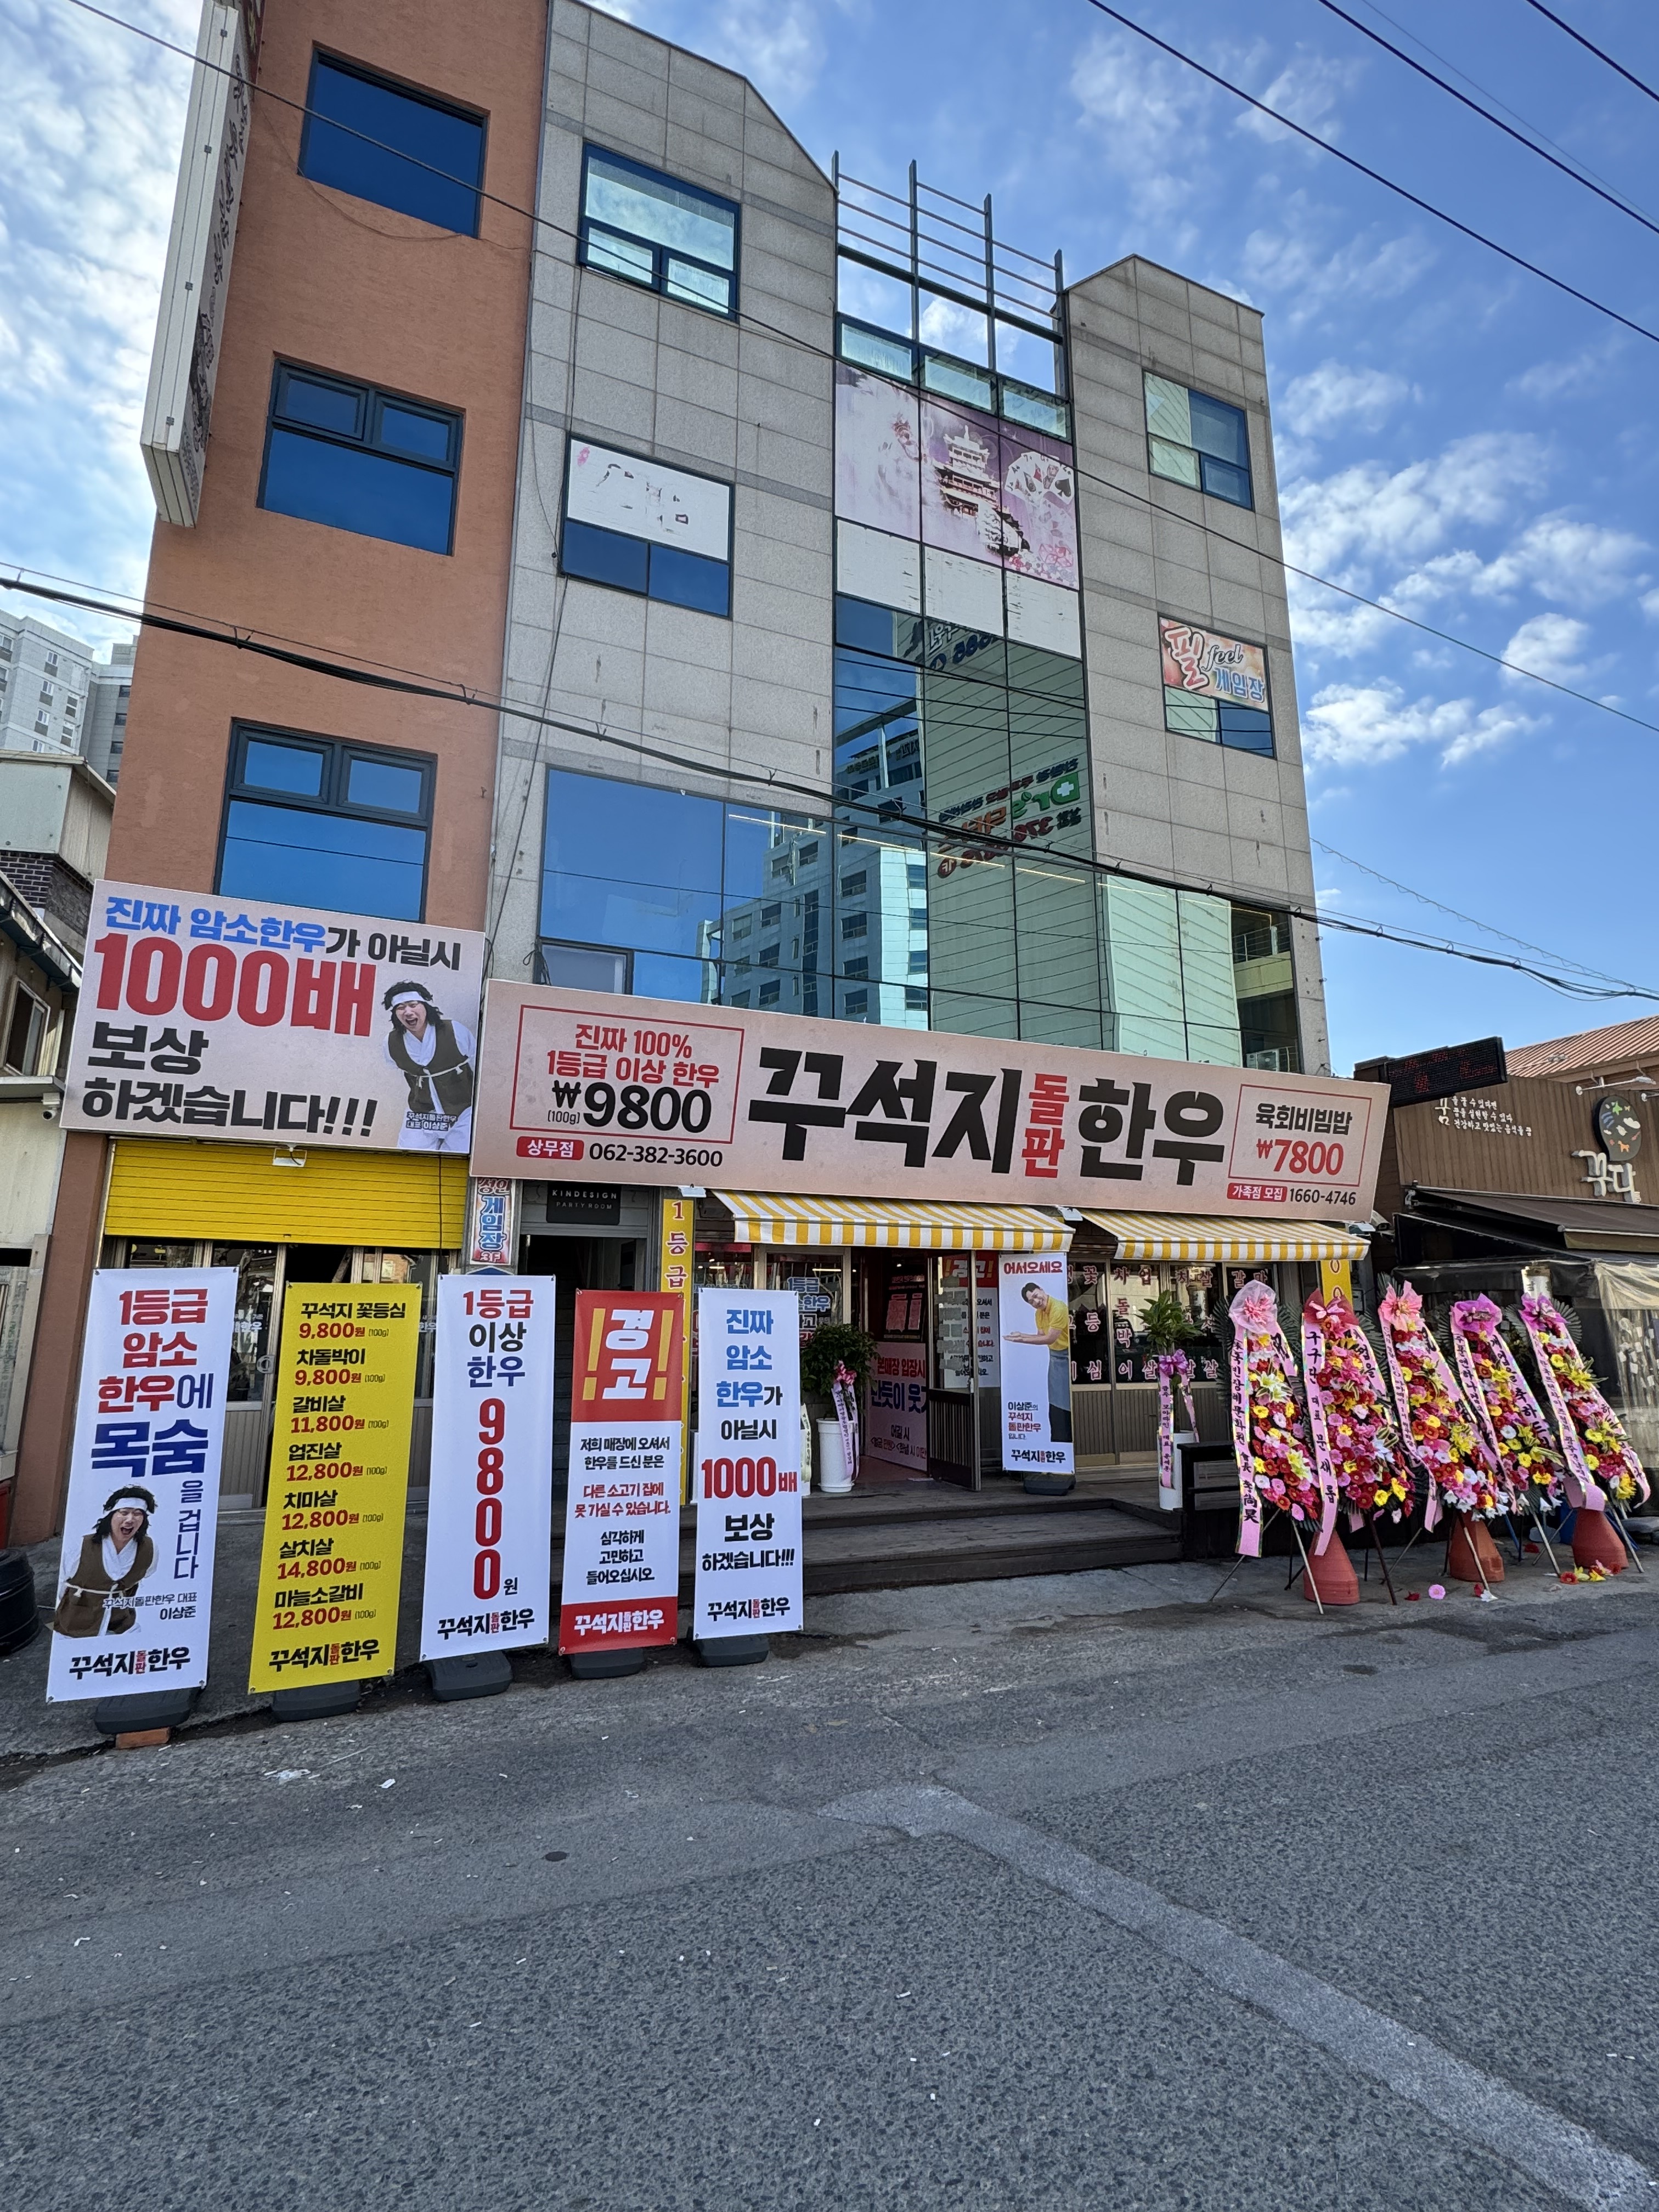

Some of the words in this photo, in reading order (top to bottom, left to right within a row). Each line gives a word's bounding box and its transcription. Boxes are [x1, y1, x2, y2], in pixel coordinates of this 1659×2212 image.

[1201, 644, 1243, 671] feel
[1214, 667, 1265, 703] 게임장
[106, 896, 181, 935] 진짜
[189, 907, 361, 957] 암소한우가
[367, 933, 461, 970] 아닐시
[94, 933, 376, 1036] 1000배
[88, 1022, 209, 1075] 보상
[575, 1023, 627, 1053] 진짜
[634, 1030, 692, 1059] 100%
[546, 1049, 608, 1079] 1등급
[615, 1056, 667, 1085] 이상
[672, 1062, 720, 1088] 한우
[82, 1077, 378, 1137] 하겠습니다!!!
[547, 1110, 580, 1125] (100g)
[423, 1121, 448, 1131] 이상준
[1255, 1102, 1353, 1136] 육회비빔밥
[527, 1139, 574, 1158] 상무점
[589, 1142, 723, 1167] 062-382-3600
[1232, 1186, 1262, 1201] 가족점
[1264, 1187, 1284, 1202] 모집
[1289, 1188, 1356, 1206] 1660-4746
[481, 1196, 507, 1251] 게임장
[1004, 1261, 1063, 1274] 어서오세요
[787, 1277, 820, 1294] 1등급
[119, 1289, 208, 1325] 1등급
[301, 1302, 352, 1319] 꾸석지
[357, 1302, 406, 1319] 꽃등심
[463, 1289, 534, 1319] 1등급
[299, 1322, 365, 1339] 9,800원
[726, 1309, 774, 1335] 진짜
[469, 1322, 527, 1353] 이상
[123, 1331, 198, 1368] 암소
[296, 1348, 365, 1365] 차돌박이
[726, 1345, 772, 1370] 암소
[295, 1369, 361, 1386] 9,800원
[467, 1356, 525, 1388] 한우
[98, 1373, 213, 1414] 한우에
[716, 1381, 783, 1408] 한우가
[293, 1395, 346, 1414] 갈비살
[291, 1415, 365, 1434] 11,800원
[1008, 1412, 1032, 1421] 꾸석지
[721, 1419, 777, 1440] 아닐시
[1008, 1423, 1041, 1432] 돌판한우
[91, 1419, 208, 1478] 목숨
[289, 1442, 342, 1461] 업진살
[580, 1437, 602, 1451] 저희
[604, 1437, 636, 1451] 매장에
[638, 1436, 670, 1450] 오셔서
[286, 1462, 363, 1481] 12,800원
[584, 1456, 617, 1470] 한우를
[620, 1455, 641, 1469] 드신
[642, 1455, 664, 1469] 분은
[701, 1457, 797, 1499] 1000배
[283, 1490, 338, 1509] 치마살
[583, 1485, 605, 1498] 다른
[607, 1483, 640, 1497] 소고기
[642, 1482, 664, 1496] 집에
[282, 1510, 359, 1530] 12,800원
[575, 1504, 586, 1519] 못
[588, 1503, 610, 1517] 가실
[612, 1502, 623, 1516] 수
[625, 1500, 671, 1515] 있습니다.
[600, 1530, 644, 1545] 심각하게
[724, 1513, 775, 1542] 보상
[173, 1509, 201, 1579] 겁니다
[279, 1538, 334, 1559] 살치살
[599, 1549, 644, 1565] 고민하고
[702, 1548, 795, 1571] 하겠습니다!!!
[277, 1558, 356, 1579] 14,800원
[586, 1567, 655, 1585] 들어오십시오
[177, 1592, 198, 1603] 대표
[274, 1583, 363, 1608] 마늘소갈비
[160, 1605, 196, 1620] 이상준
[273, 1607, 351, 1630] 12,800원
